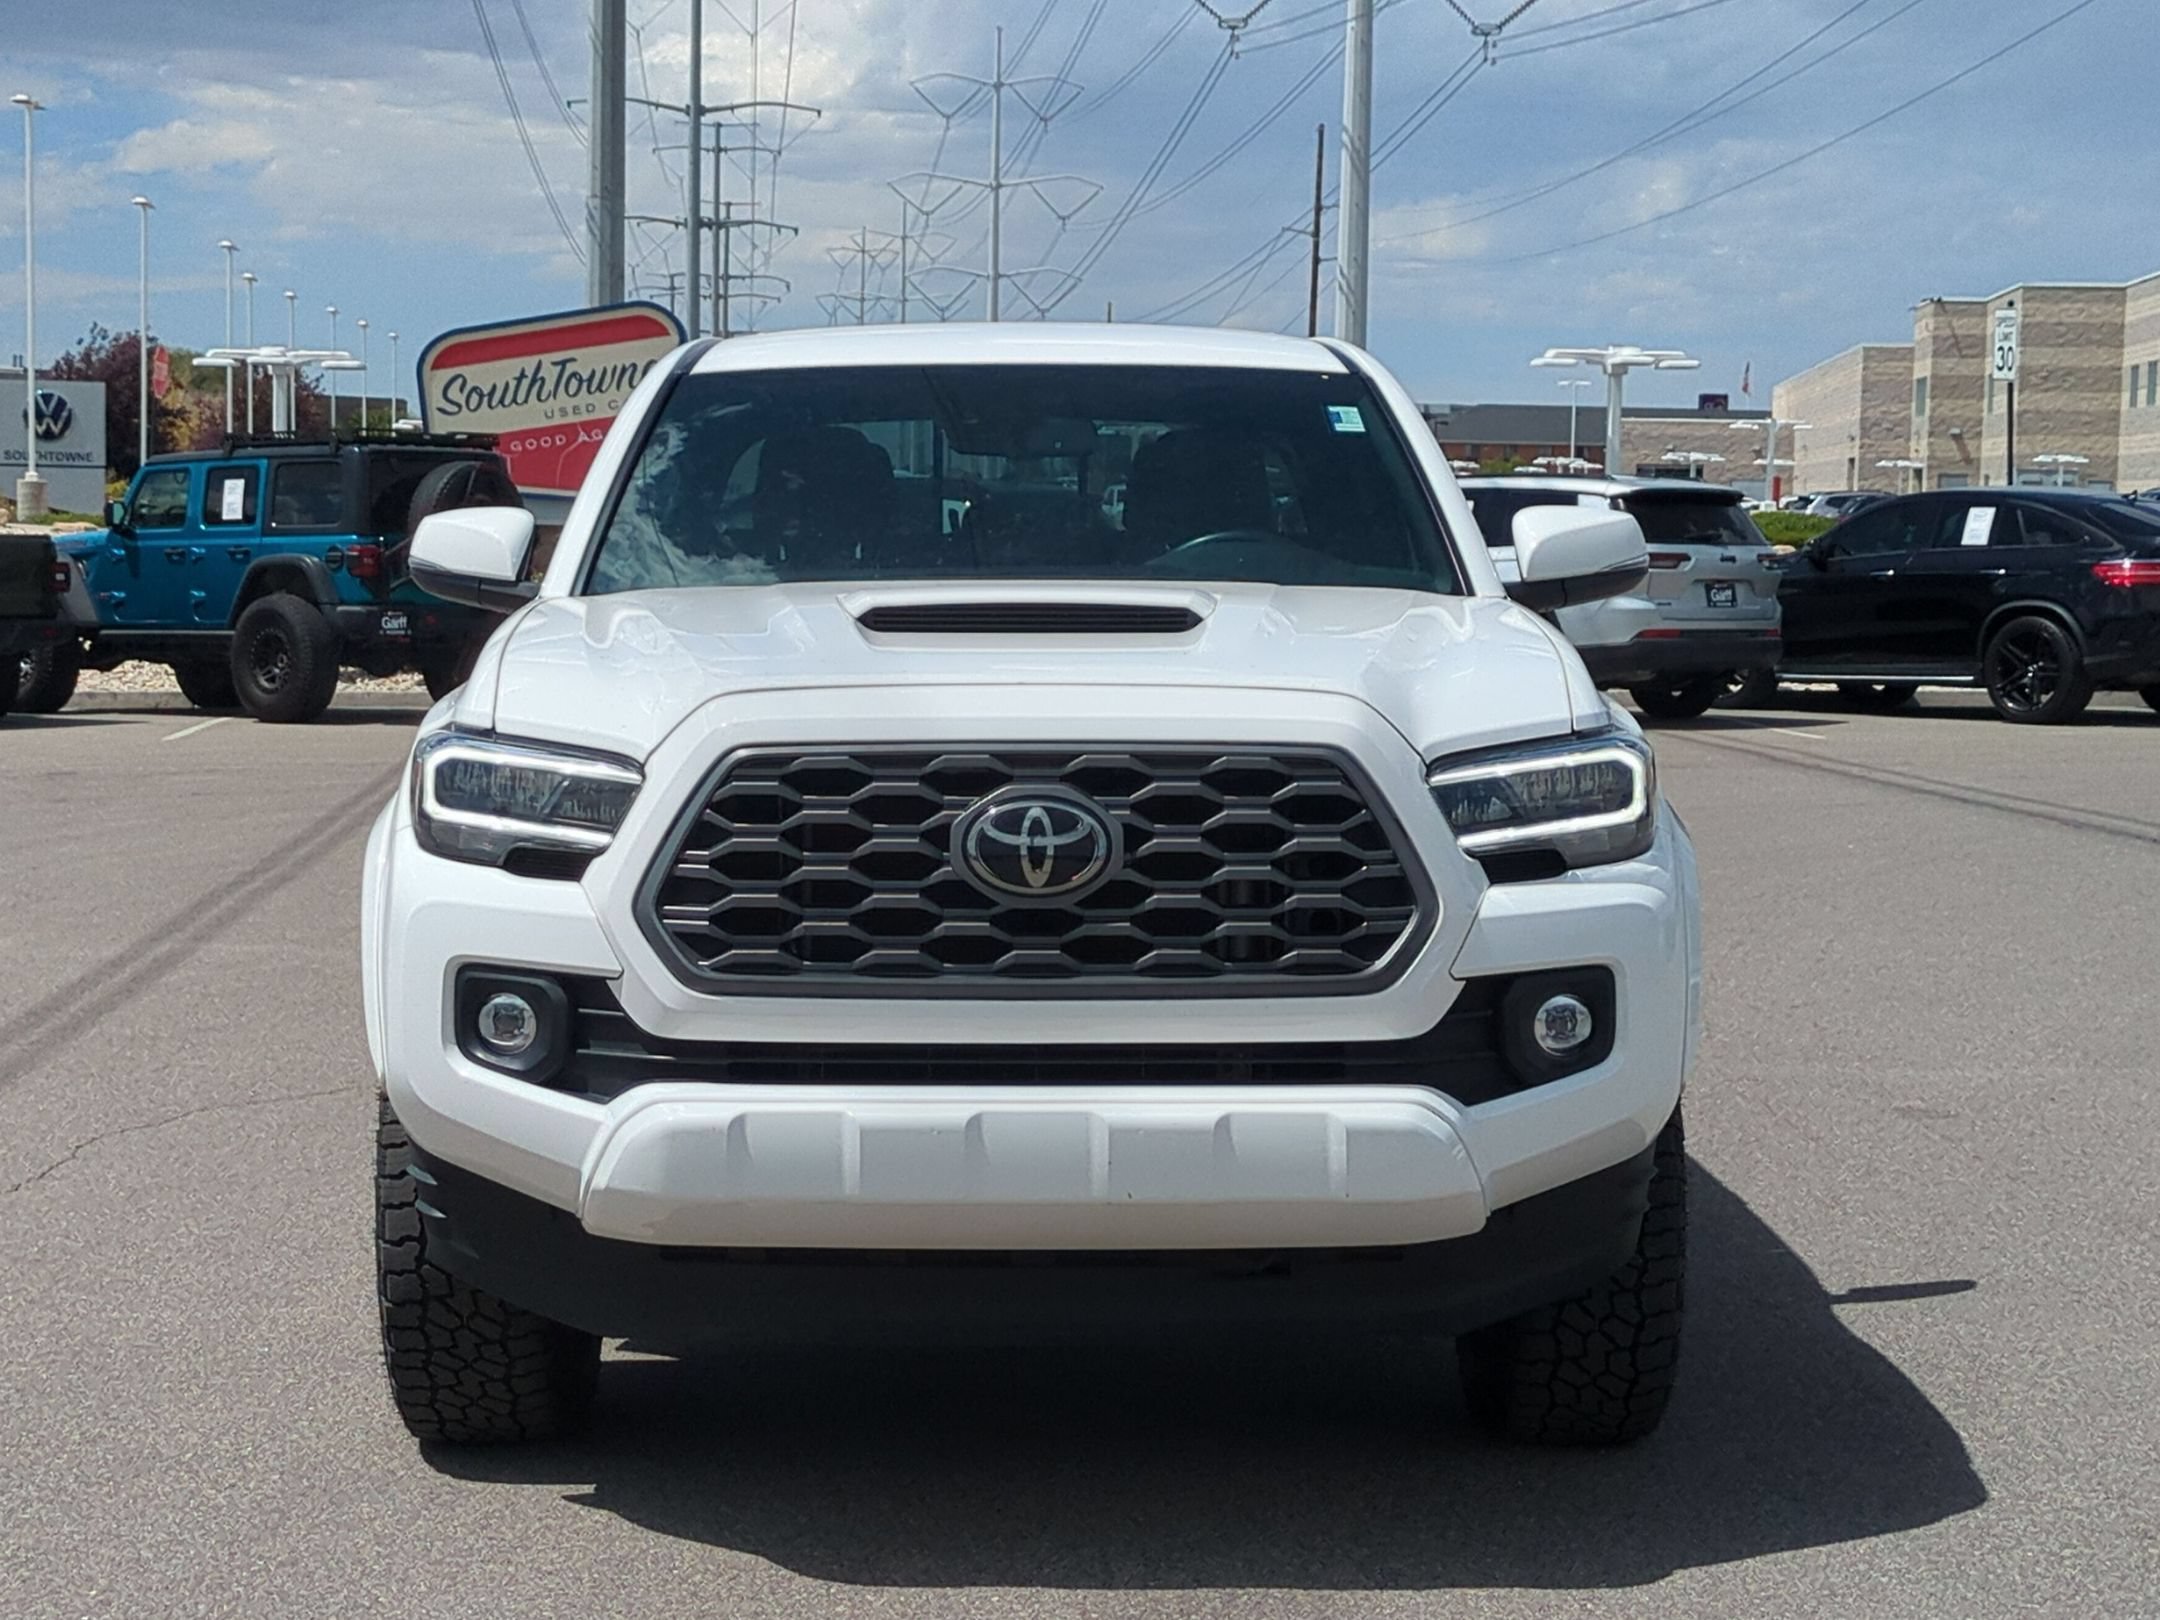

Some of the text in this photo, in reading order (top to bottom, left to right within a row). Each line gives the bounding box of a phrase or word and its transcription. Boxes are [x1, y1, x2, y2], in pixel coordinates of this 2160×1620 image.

[1996, 345, 2014, 372] 30
[544, 402, 597, 420] USED
[510, 434, 567, 452] GOOD
[381, 615, 408, 629] Garff
